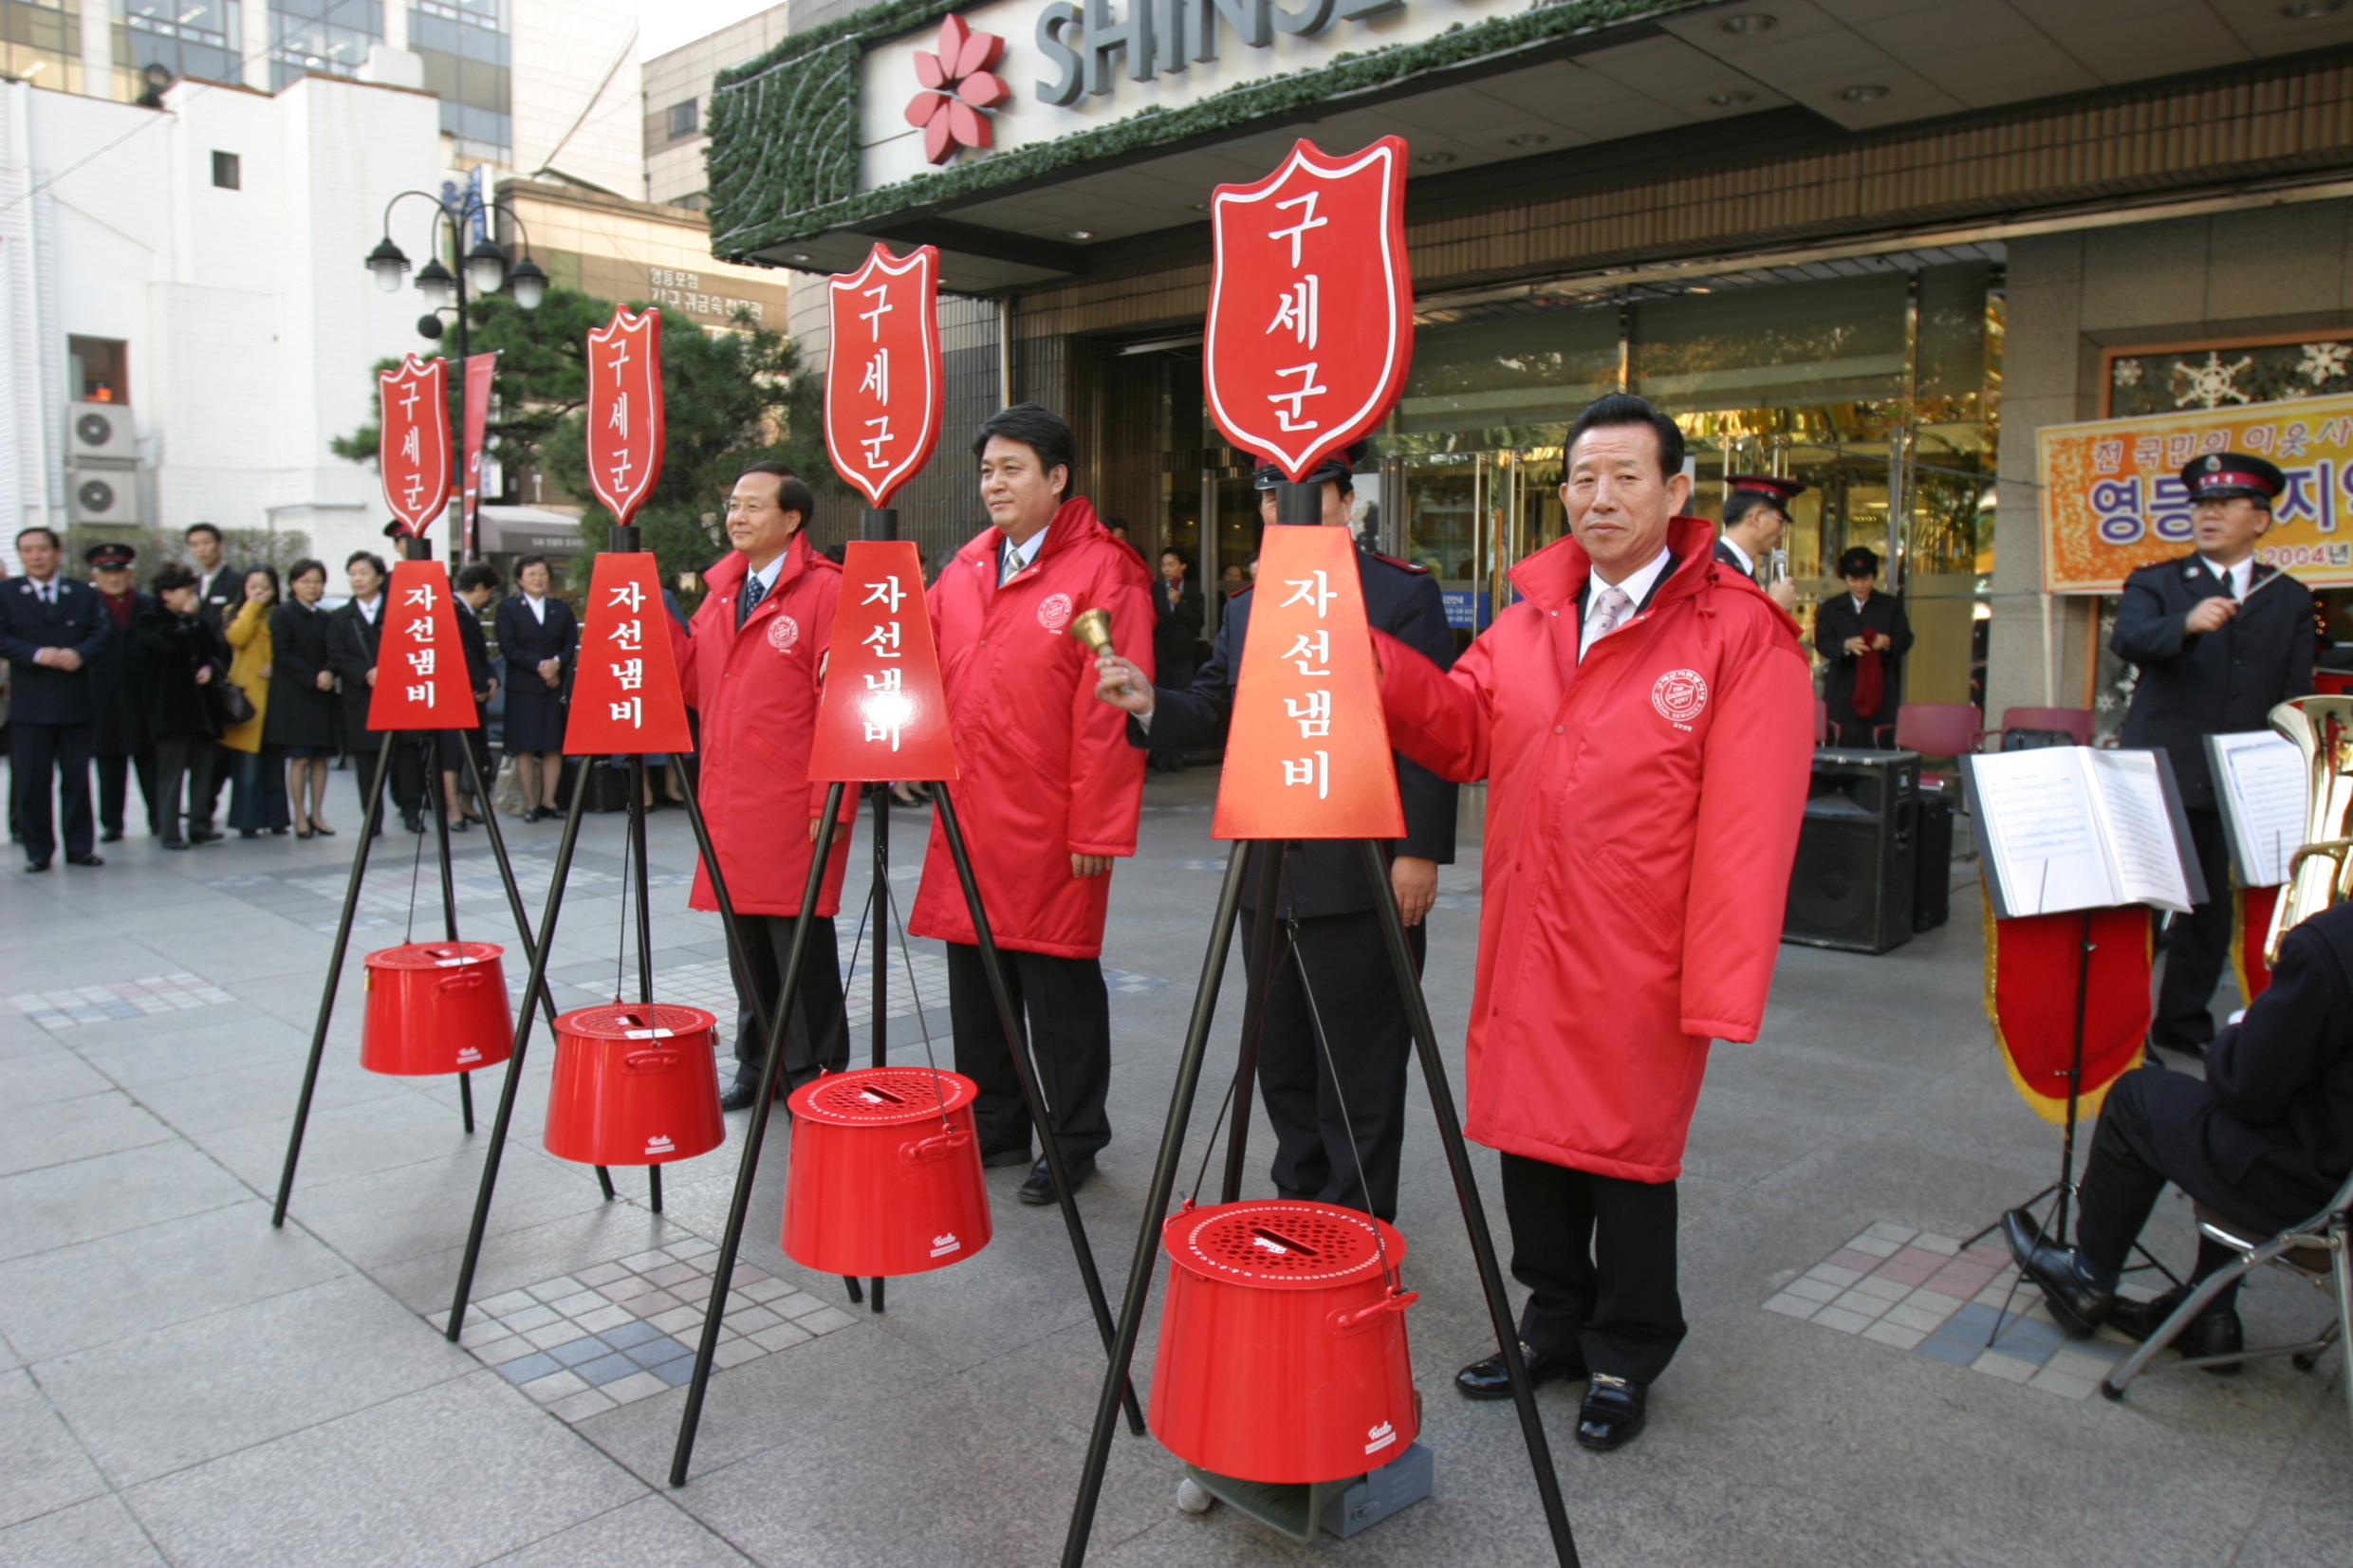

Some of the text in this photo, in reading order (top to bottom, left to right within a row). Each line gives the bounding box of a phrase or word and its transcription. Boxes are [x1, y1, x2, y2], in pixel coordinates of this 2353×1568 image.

[859, 284, 894, 469] 구세군
[1266, 190, 1328, 433] 구세군
[398, 381, 424, 511] 구세군
[608, 339, 632, 492] 구세군
[404, 583, 437, 709] 자선냄비
[607, 581, 646, 729] 자선냄비
[862, 576, 907, 752] 자선냄비
[1280, 569, 1339, 800] 자선냄비
